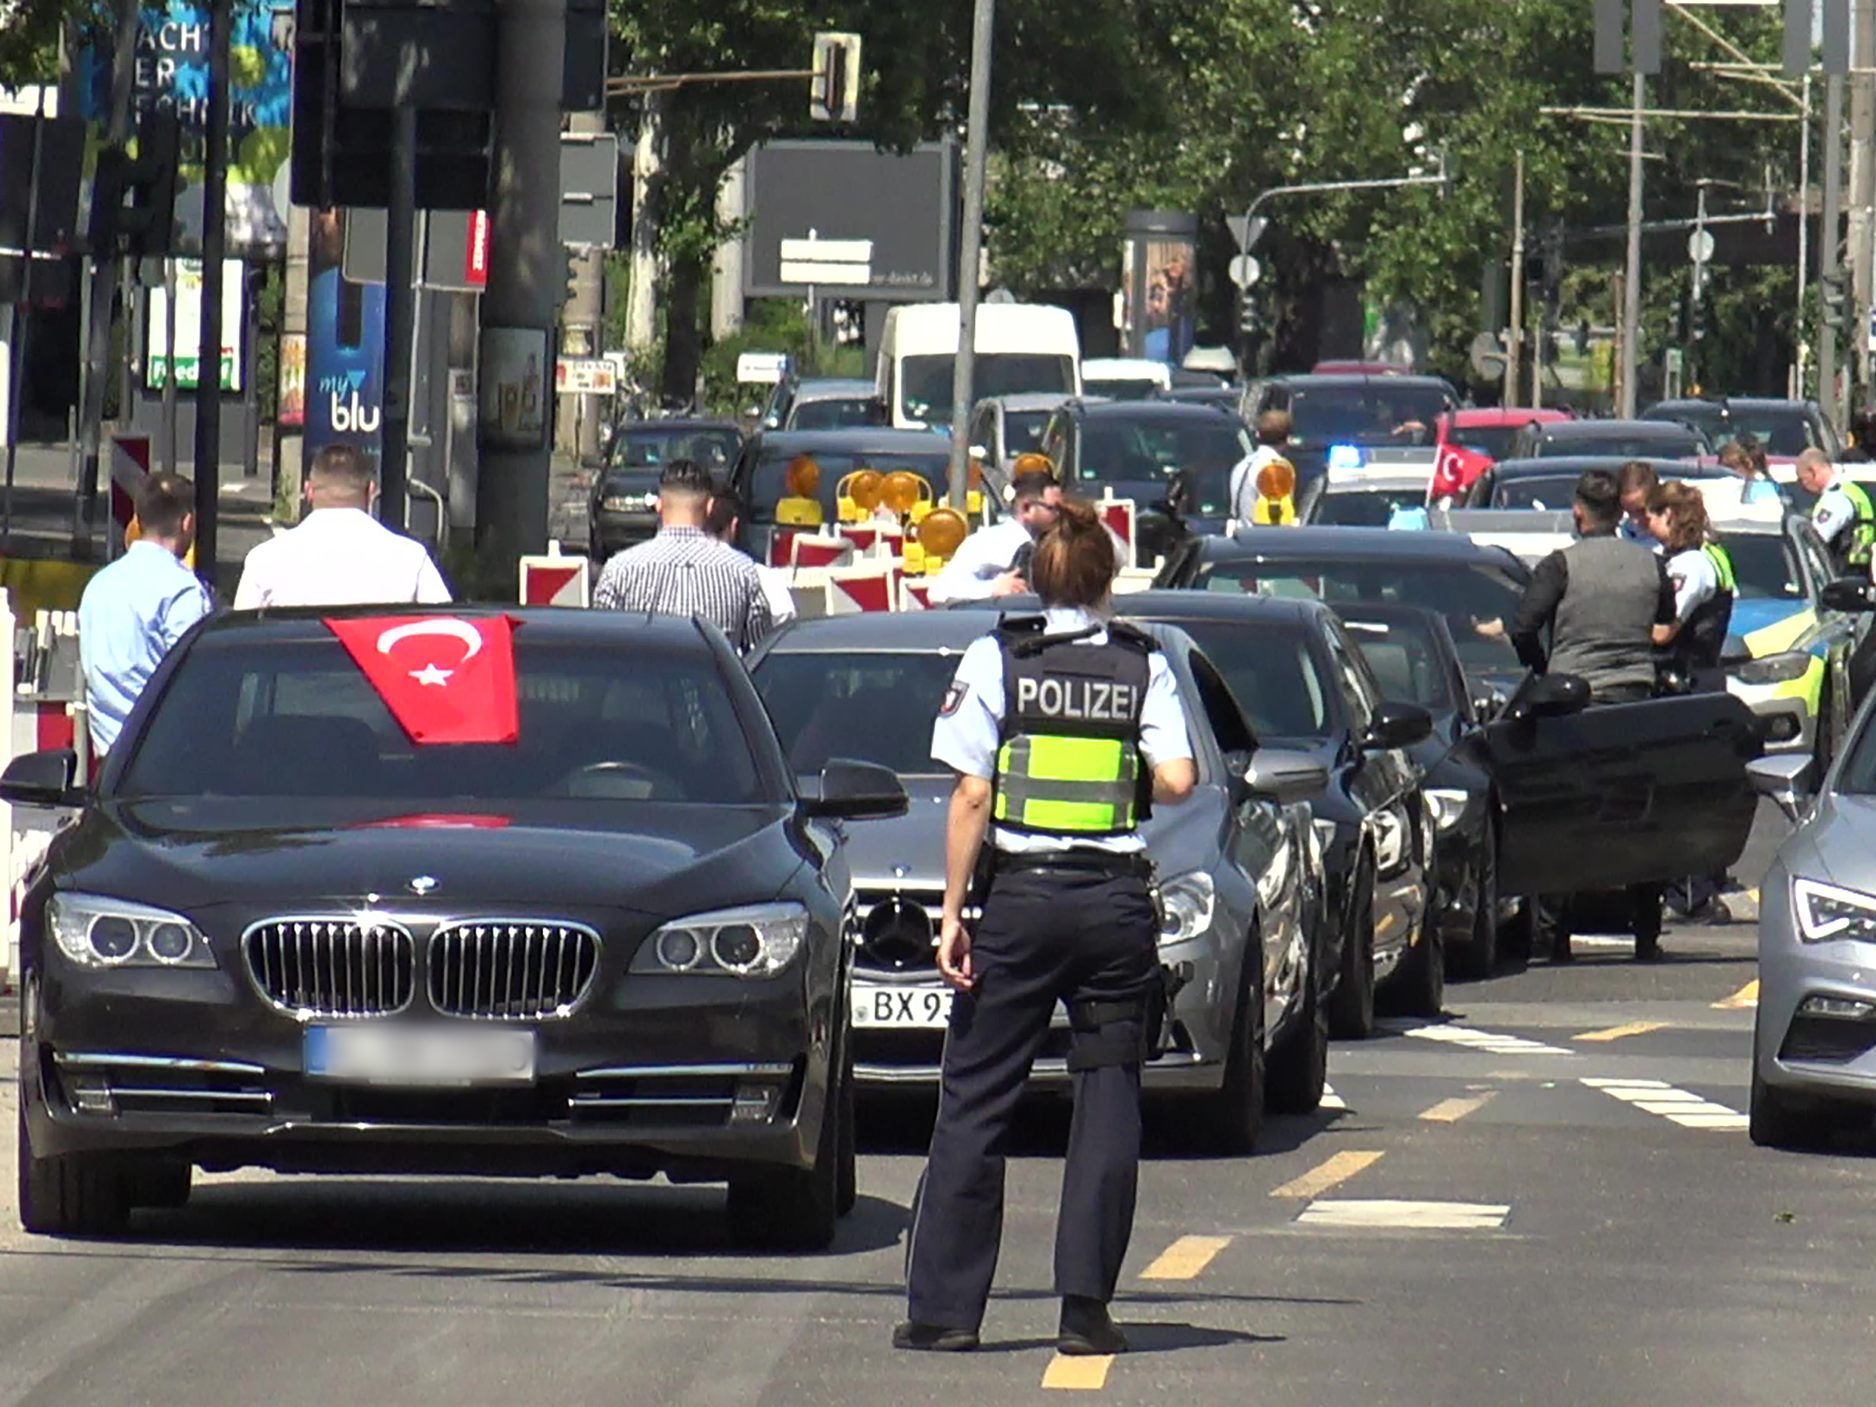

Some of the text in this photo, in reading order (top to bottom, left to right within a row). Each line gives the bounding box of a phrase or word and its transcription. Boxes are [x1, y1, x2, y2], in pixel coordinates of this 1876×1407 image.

[136, 21, 209, 52] ACH
[135, 57, 176, 88] ER
[318, 375, 349, 403] my
[332, 390, 380, 432] blu
[1017, 677, 1138, 720] POLIZEI
[873, 991, 915, 1022] BX
